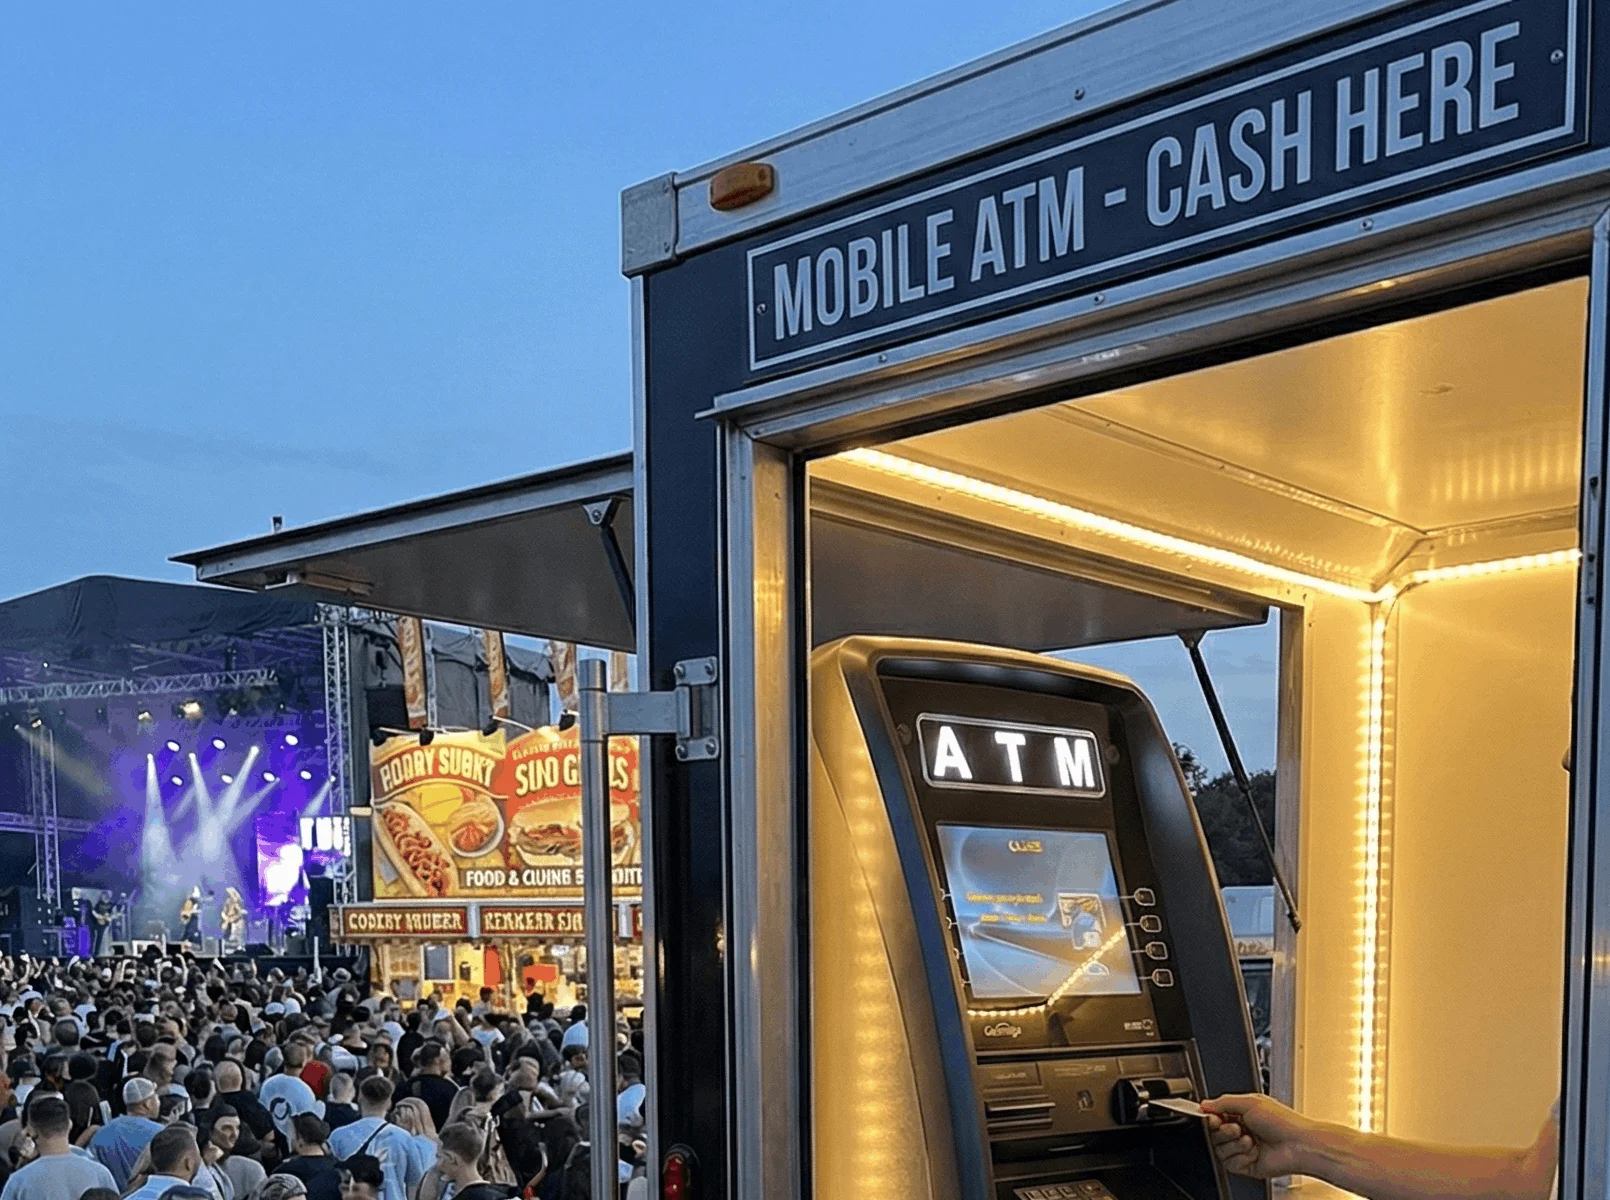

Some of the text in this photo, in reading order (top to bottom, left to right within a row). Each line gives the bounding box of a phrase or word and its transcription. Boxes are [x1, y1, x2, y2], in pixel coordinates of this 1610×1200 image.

[773, 212, 955, 341] MOBILE
[970, 166, 1085, 284] ATM
[1146, 91, 1312, 227] CASH
[1337, 22, 1521, 171] HERE
[466, 871, 505, 886] FOOD
[508, 871, 519, 886] &
